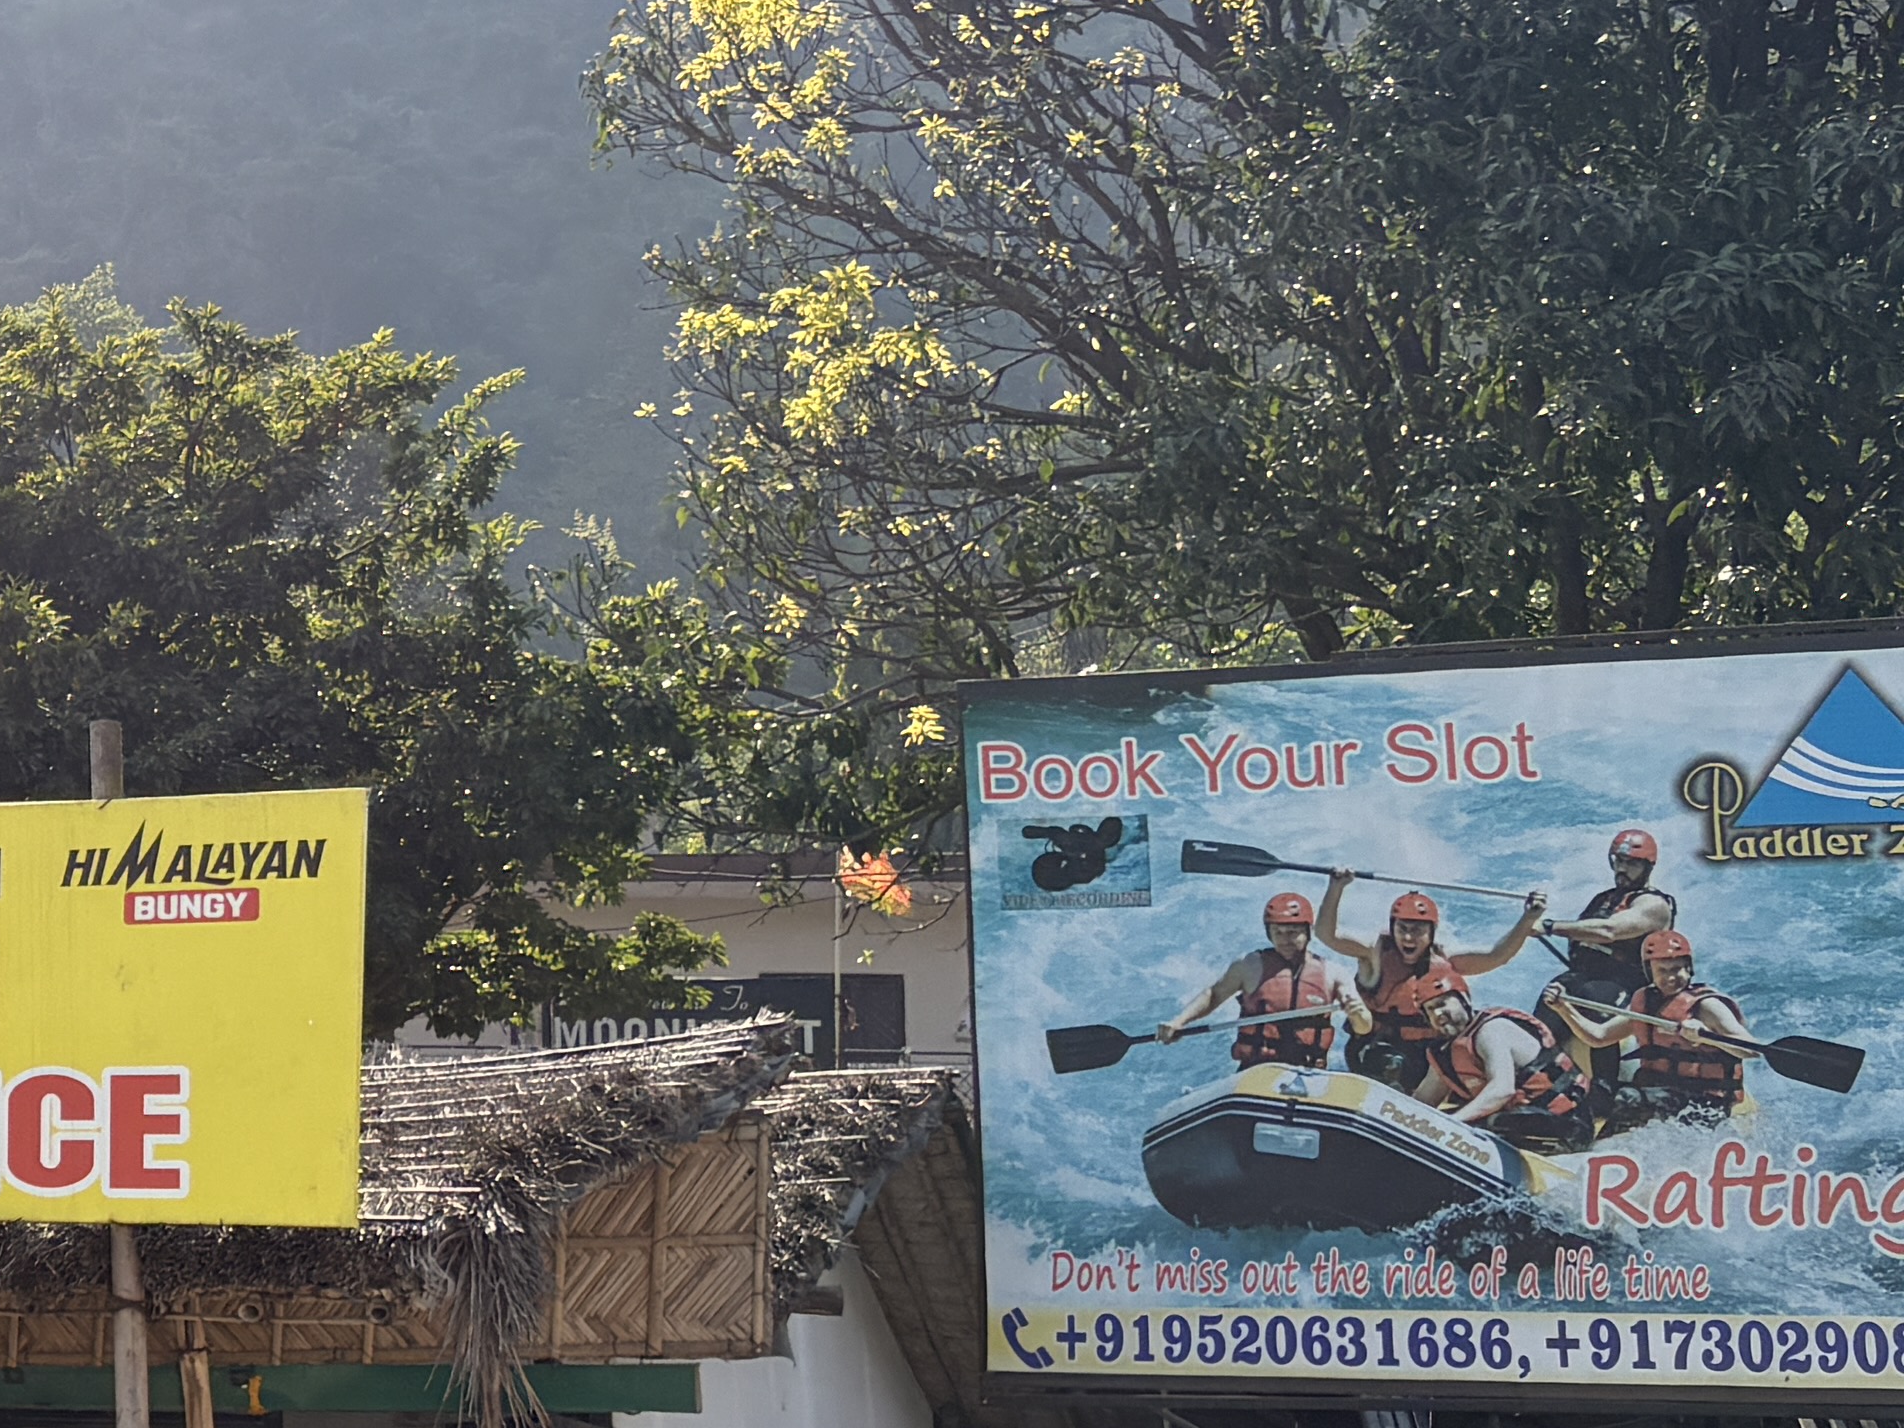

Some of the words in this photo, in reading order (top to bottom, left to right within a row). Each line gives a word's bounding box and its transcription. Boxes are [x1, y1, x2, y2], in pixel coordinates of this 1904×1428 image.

[979, 738, 1165, 803] Book
[1182, 732, 1359, 795] Your
[1386, 722, 1537, 785] Slot
[1684, 763, 1868, 860] Paddler
[60, 819, 328, 891] HIMALAYAN
[134, 892, 248, 921] BUNGY
[553, 1017, 822, 1055] MOONT
[1379, 1099, 1446, 1142] Paddler
[1447, 1131, 1490, 1165] Zone
[1051, 1250, 1140, 1294] Don't
[1155, 1247, 1227, 1296] miss
[1242, 1257, 1300, 1296] out
[1313, 1246, 1370, 1298] the
[1384, 1252, 1455, 1299] ride
[1469, 1254, 1508, 1299] of
[1518, 1266, 1540, 1299] a
[1555, 1247, 1610, 1301] life
[1623, 1250, 1710, 1301] time
[1055, 1310, 1532, 1378] +919520631686,
